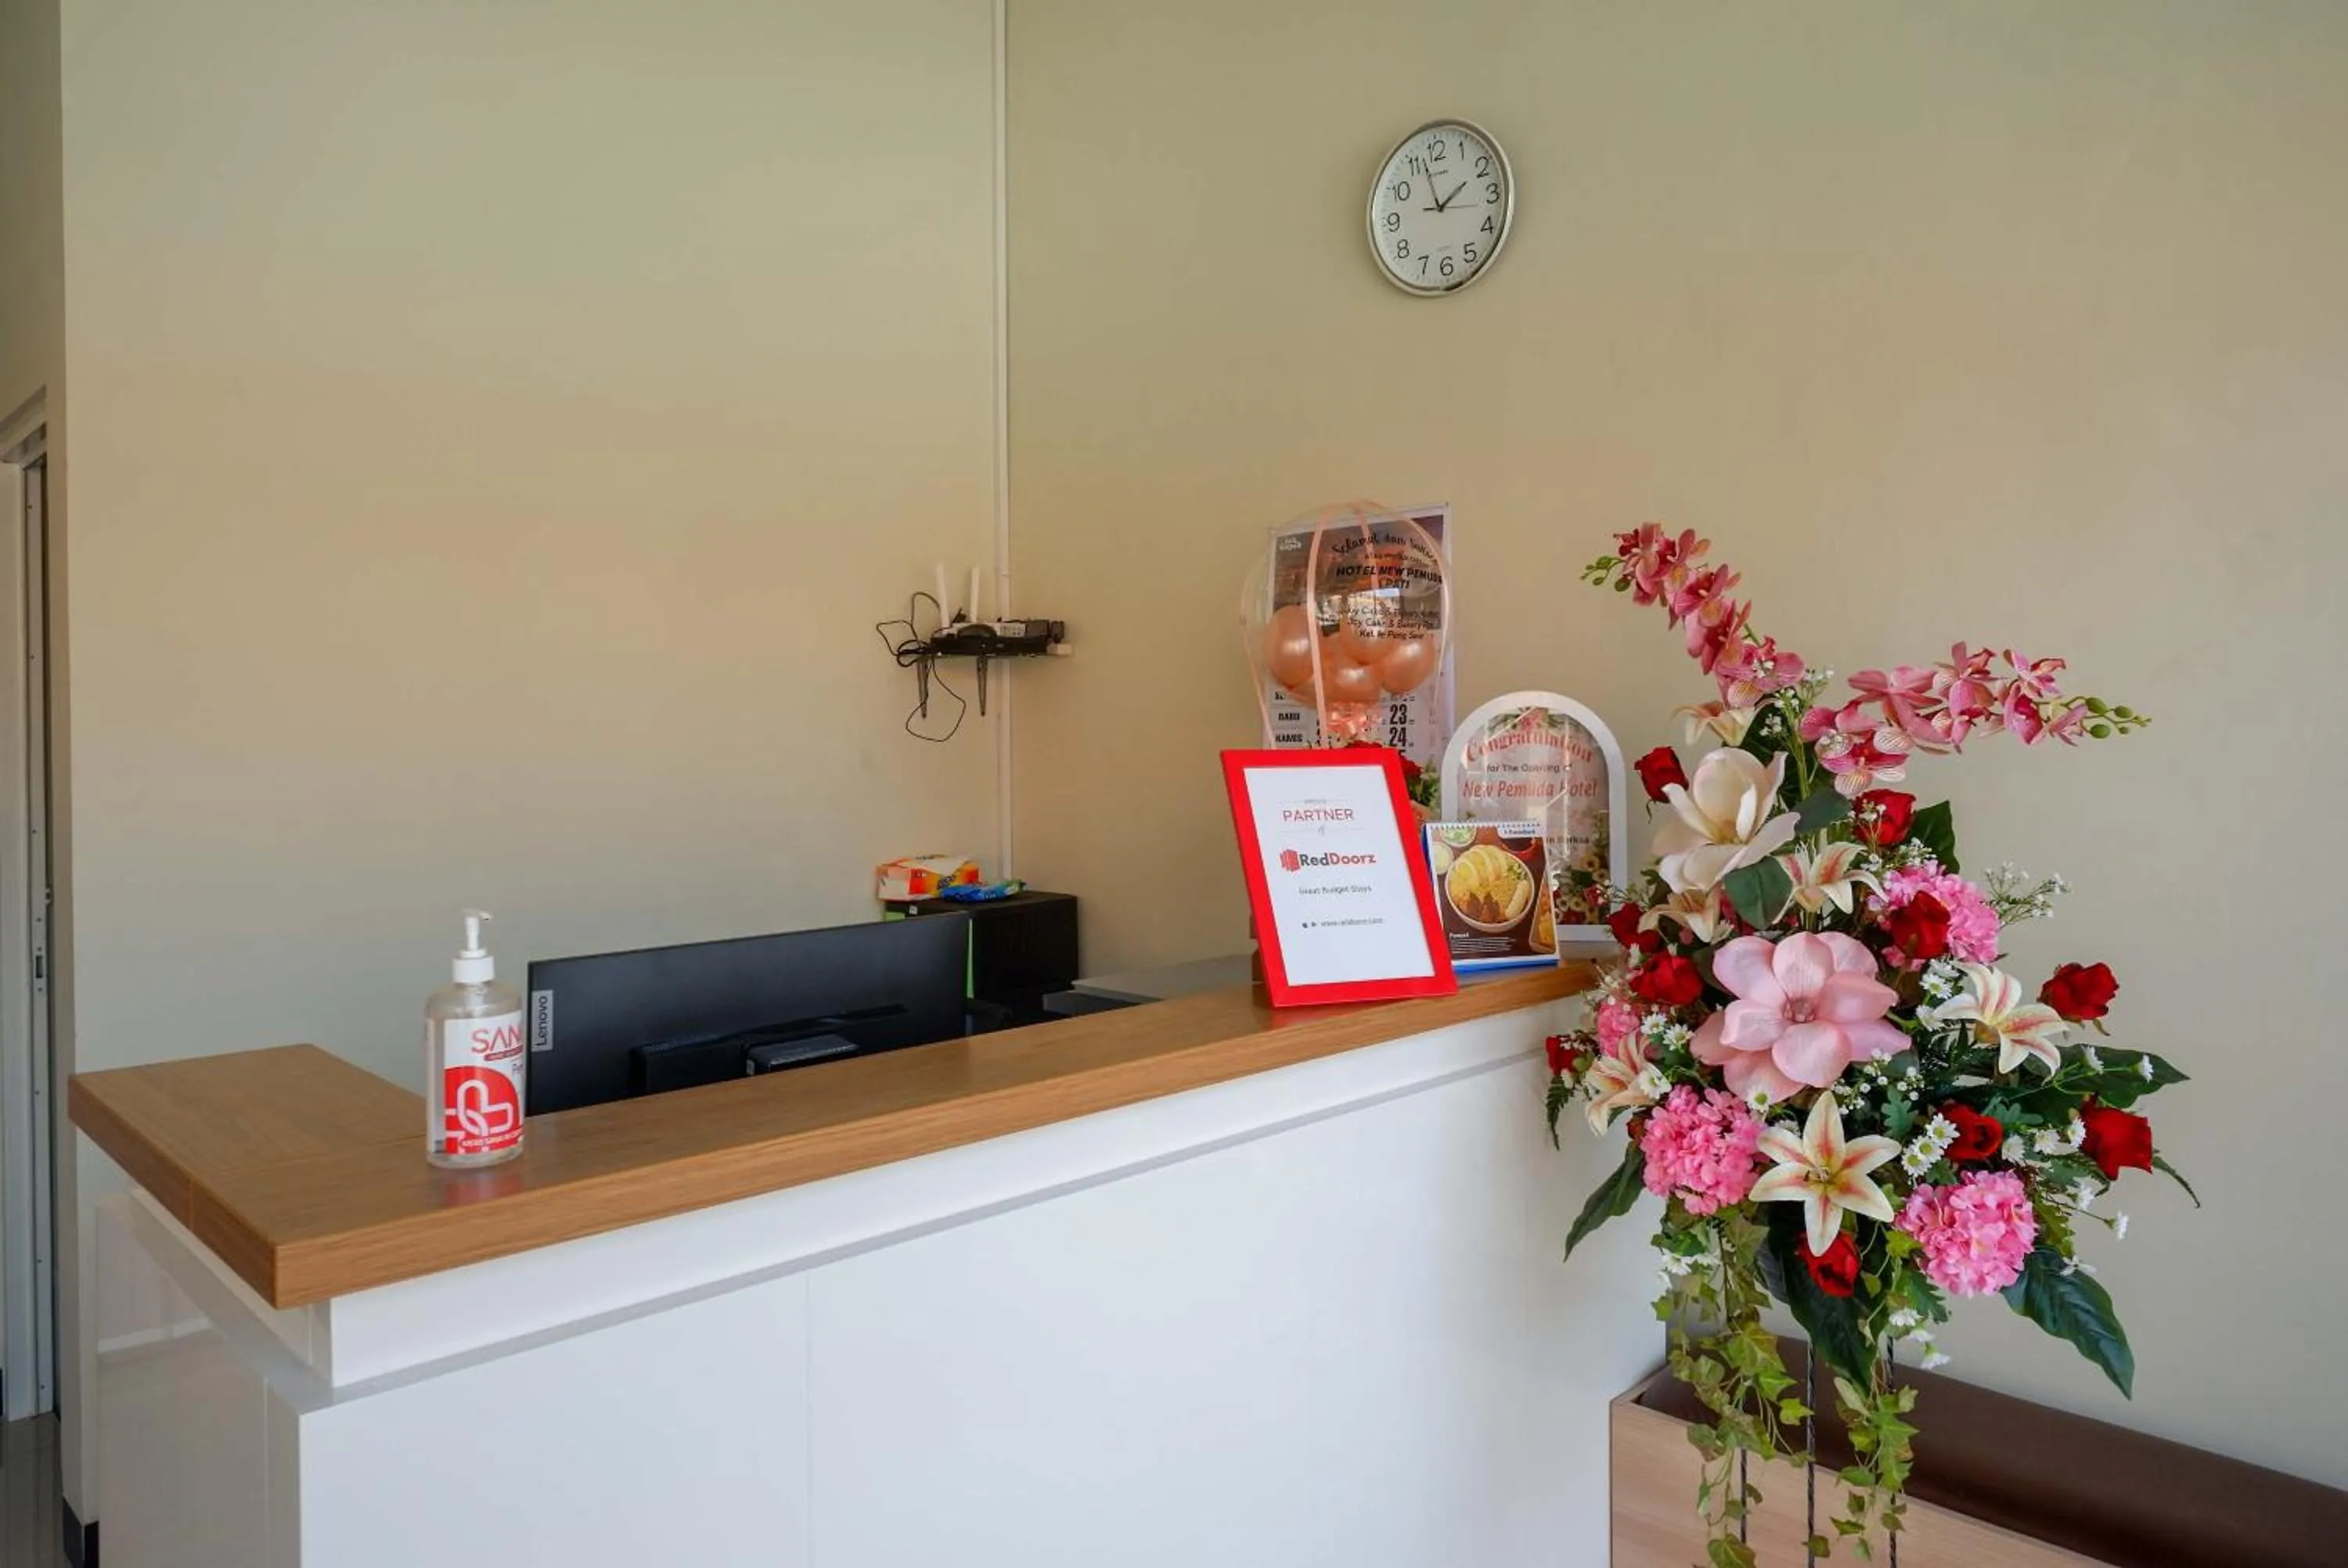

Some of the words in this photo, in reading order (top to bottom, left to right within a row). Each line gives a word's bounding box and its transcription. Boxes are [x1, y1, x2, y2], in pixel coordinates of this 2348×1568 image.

[1428, 140, 1446, 163] 12
[1459, 141, 1464, 160] 1
[1409, 156, 1421, 176] 11
[1475, 156, 1489, 178] 2
[1388, 182, 1410, 202] 10
[1486, 183, 1500, 203] 3
[1387, 213, 1400, 232] 9
[1480, 215, 1493, 234] 4
[1397, 239, 1410, 259] 8
[1464, 243, 1477, 263] 5
[1417, 255, 1429, 275] 7
[1440, 257, 1453, 276] 6
[1336, 566, 1376, 577] HOTEL
[1389, 704, 1407, 725] 23
[1389, 727, 1407, 747] 24
[1487, 764, 1500, 772] for
[1502, 764, 1519, 772] The
[1521, 764, 1560, 773] Opening
[1463, 781, 1494, 798] New
[1497, 781, 1554, 797] Pemuda
[1283, 808, 1354, 822] PARTNER
[1299, 853, 1377, 866] RedDoorz
[536, 995, 548, 1047] Lenovo
